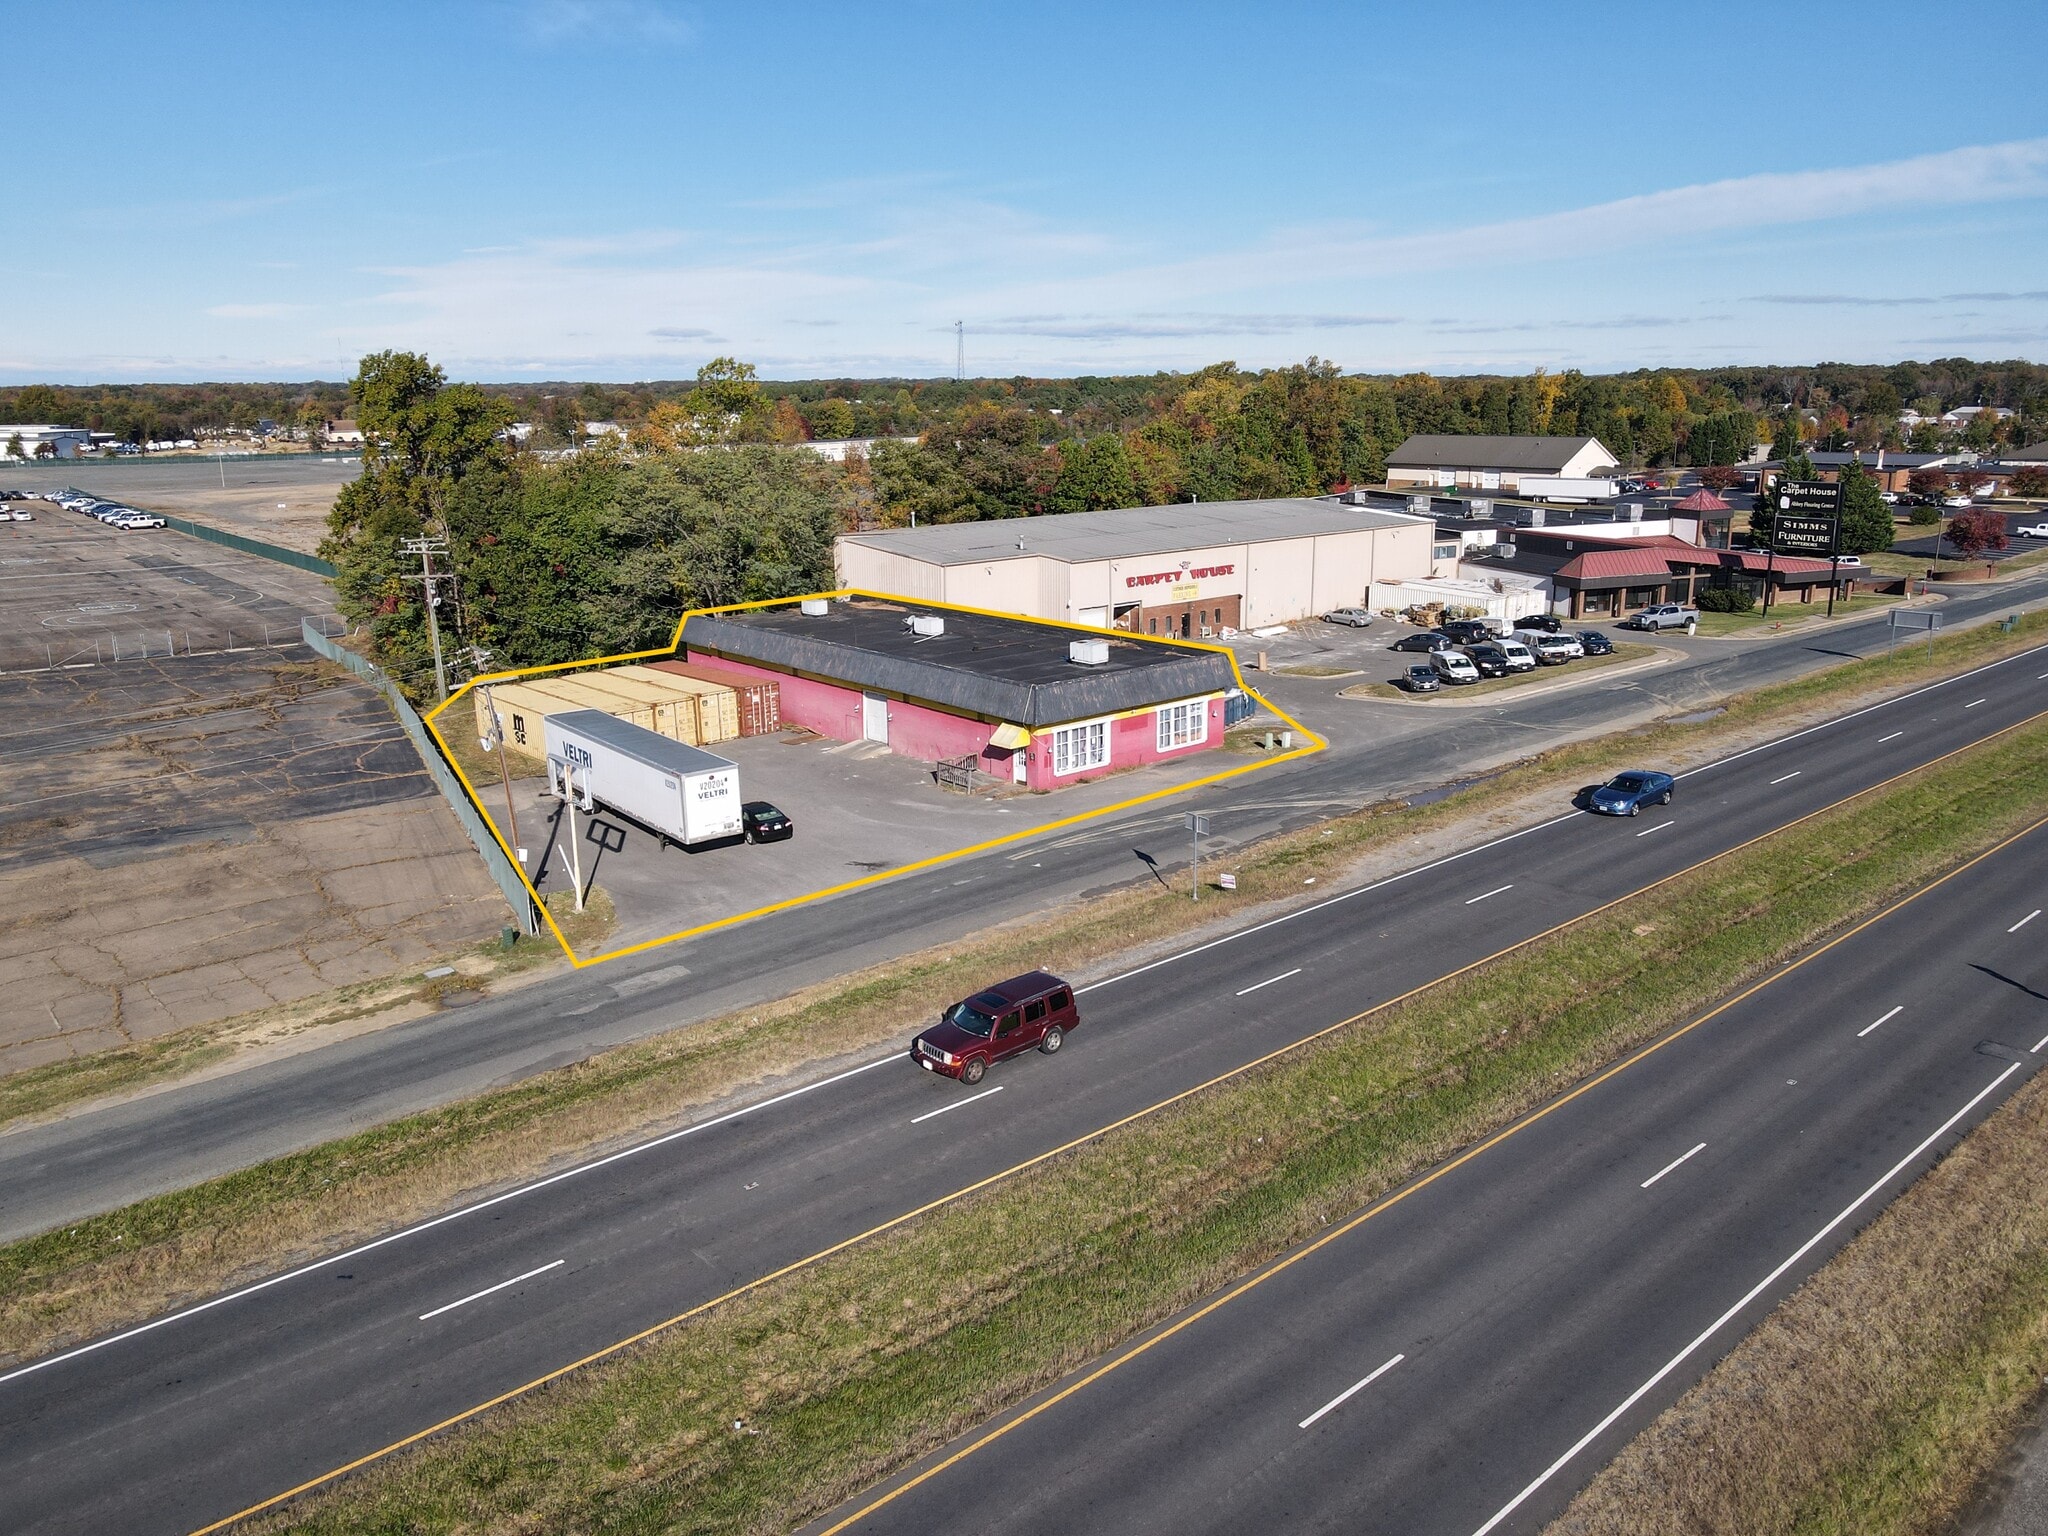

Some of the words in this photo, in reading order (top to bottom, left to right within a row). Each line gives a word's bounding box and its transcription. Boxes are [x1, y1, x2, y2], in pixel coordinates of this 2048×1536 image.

[1780, 486, 1808, 496] Carpet
[1810, 487, 1837, 496] House
[1783, 520, 1828, 531] SIMMS
[1778, 531, 1831, 543] FURNITURE
[1126, 571, 1183, 588] CARPET
[1190, 564, 1235, 580] HOUSE
[562, 740, 593, 768] VELTRI
[698, 788, 728, 799] VELTRI
